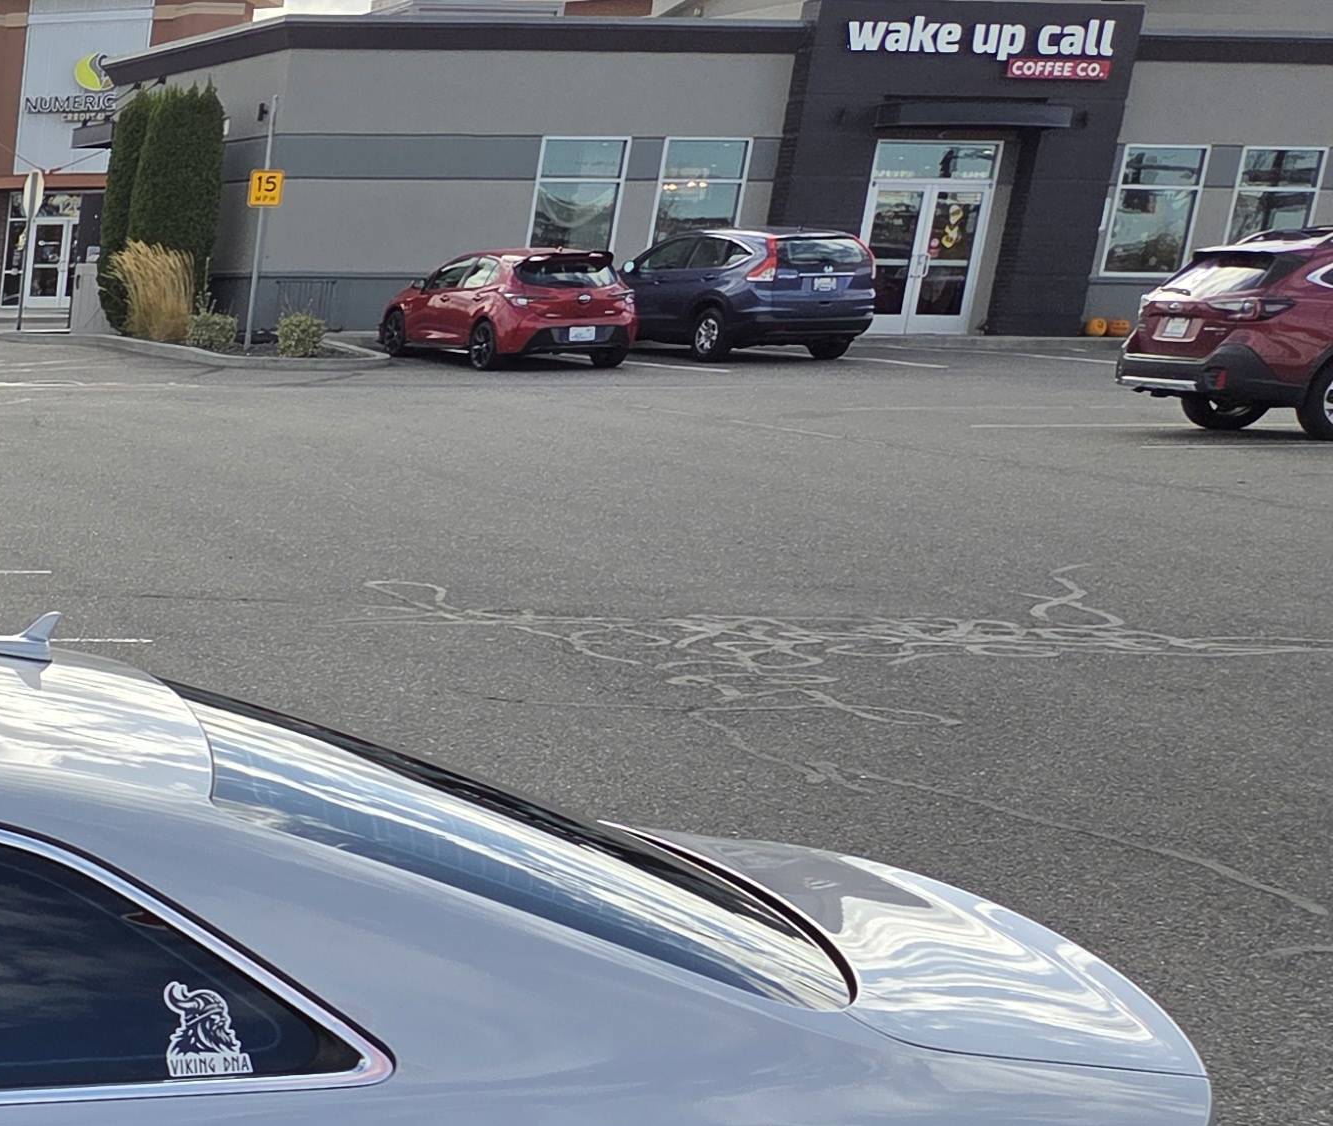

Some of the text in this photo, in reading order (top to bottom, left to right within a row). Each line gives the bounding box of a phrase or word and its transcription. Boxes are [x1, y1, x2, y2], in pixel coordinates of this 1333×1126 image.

[848, 15, 1116, 61] wake up call
[1011, 61, 1105, 77] COFFEE CO.
[257, 175, 277, 192] 15
[170, 1055, 249, 1075] VIKING DNA
